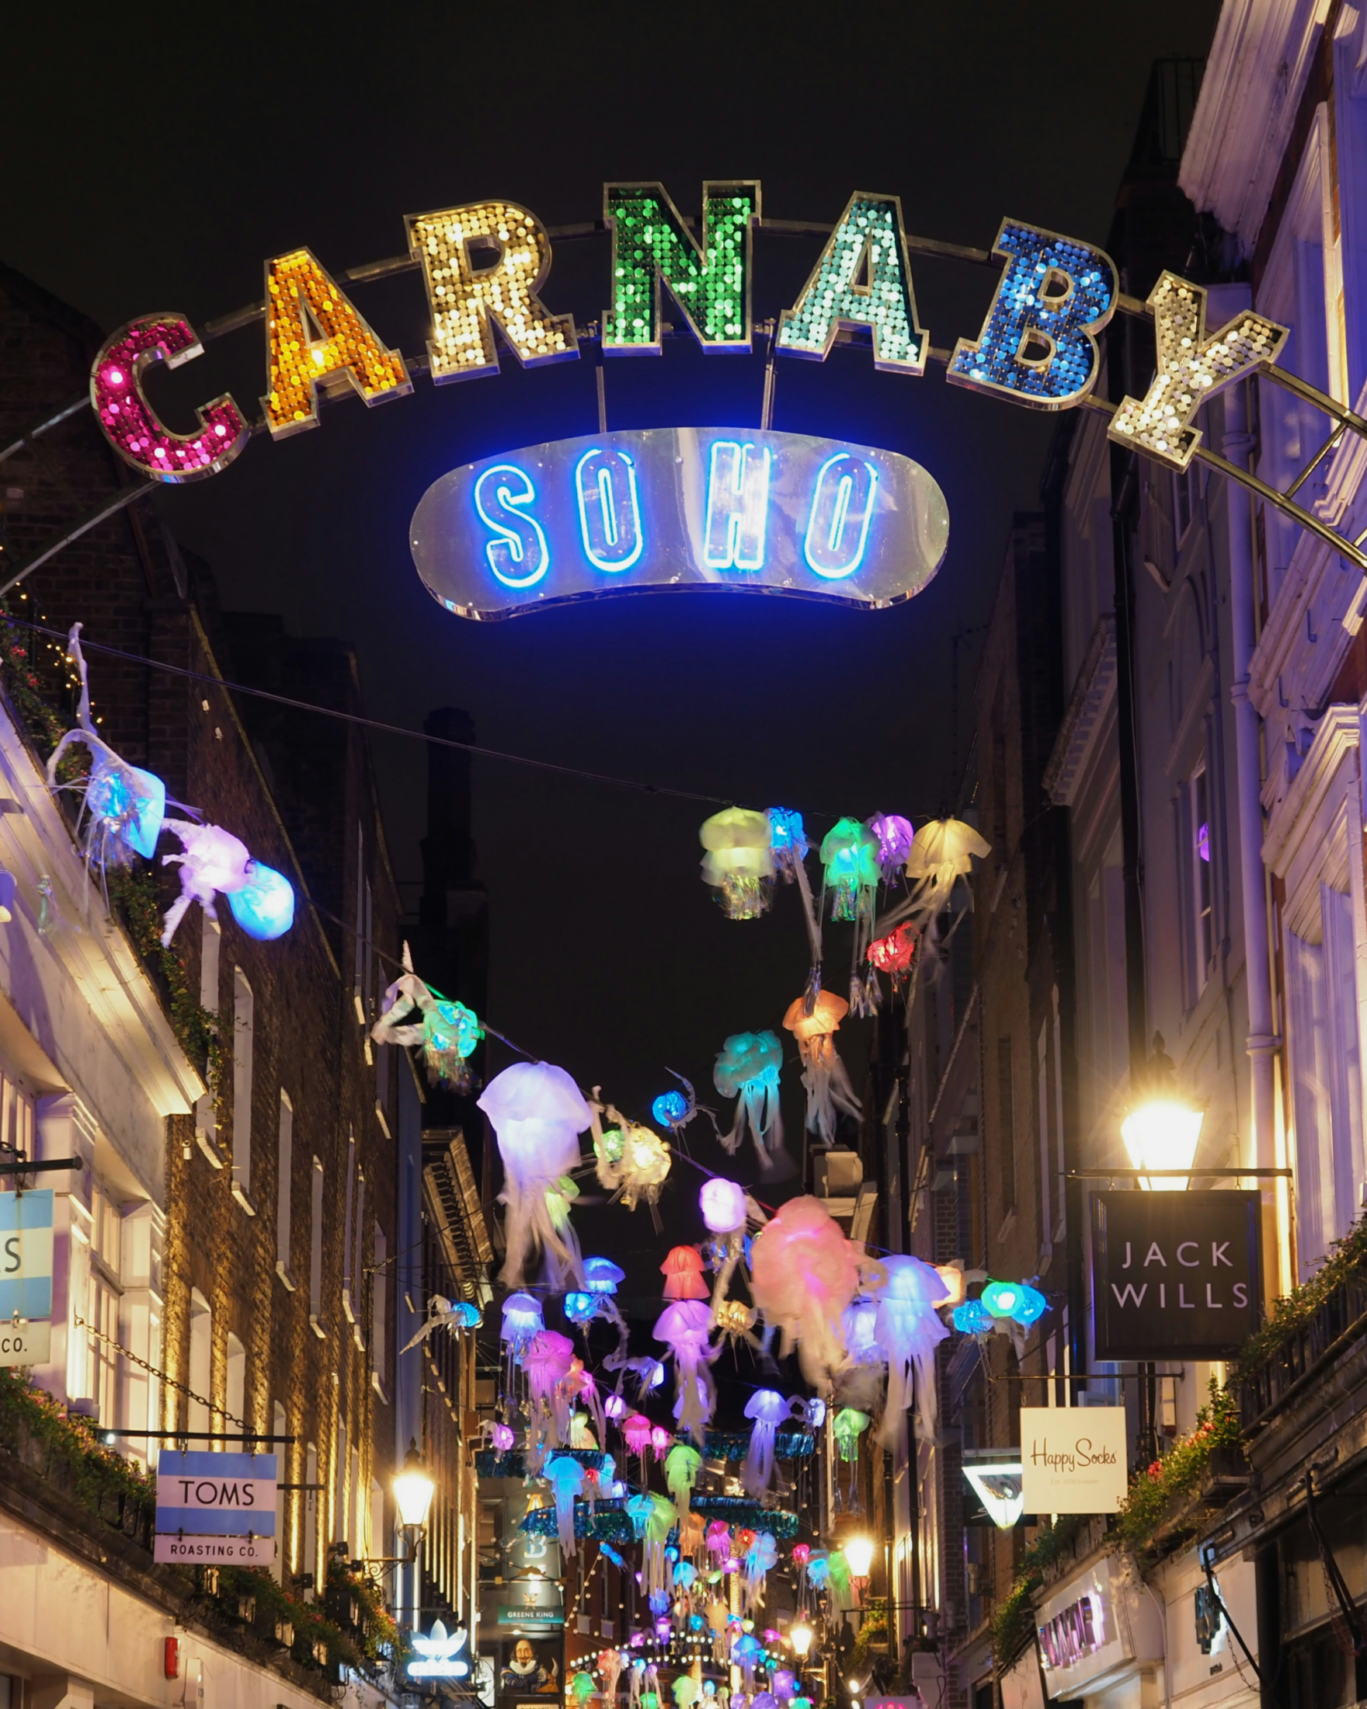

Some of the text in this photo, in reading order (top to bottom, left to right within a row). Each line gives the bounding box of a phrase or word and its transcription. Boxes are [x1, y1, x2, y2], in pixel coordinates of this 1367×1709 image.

[90, 180, 1289, 483] CARNABY
[473, 440, 879, 588] SOHO
[1121, 1241, 1234, 1269] JACK
[1110, 1282, 1249, 1309] WILLS
[1030, 1437, 1117, 1473] Happy Socks
[178, 1480, 255, 1506] TOMS
[170, 1544, 259, 1557] ROASTING CO.
